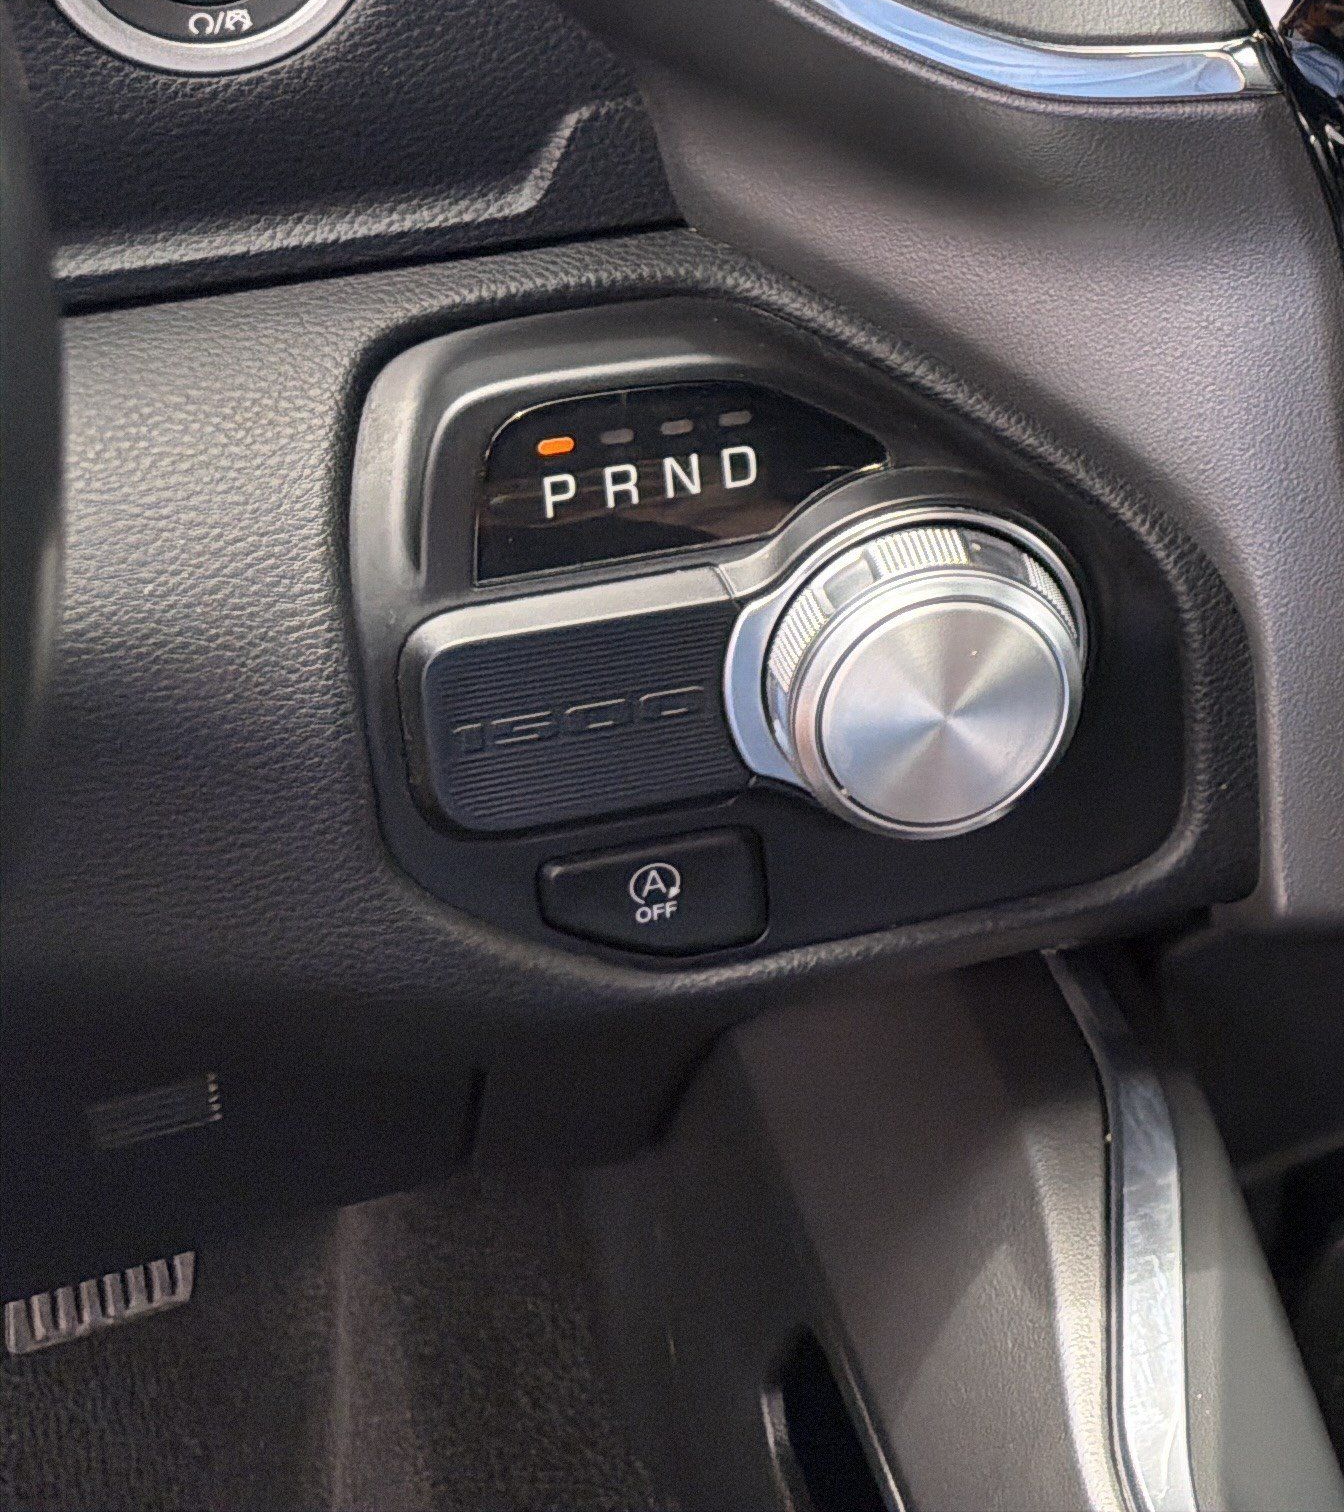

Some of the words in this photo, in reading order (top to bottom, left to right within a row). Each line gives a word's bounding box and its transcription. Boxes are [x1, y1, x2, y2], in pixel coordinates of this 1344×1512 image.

[543, 472, 576, 519] P
[603, 464, 639, 509] R
[663, 452, 701, 499] N
[721, 444, 759, 489] D
[635, 900, 678, 924] OFF
